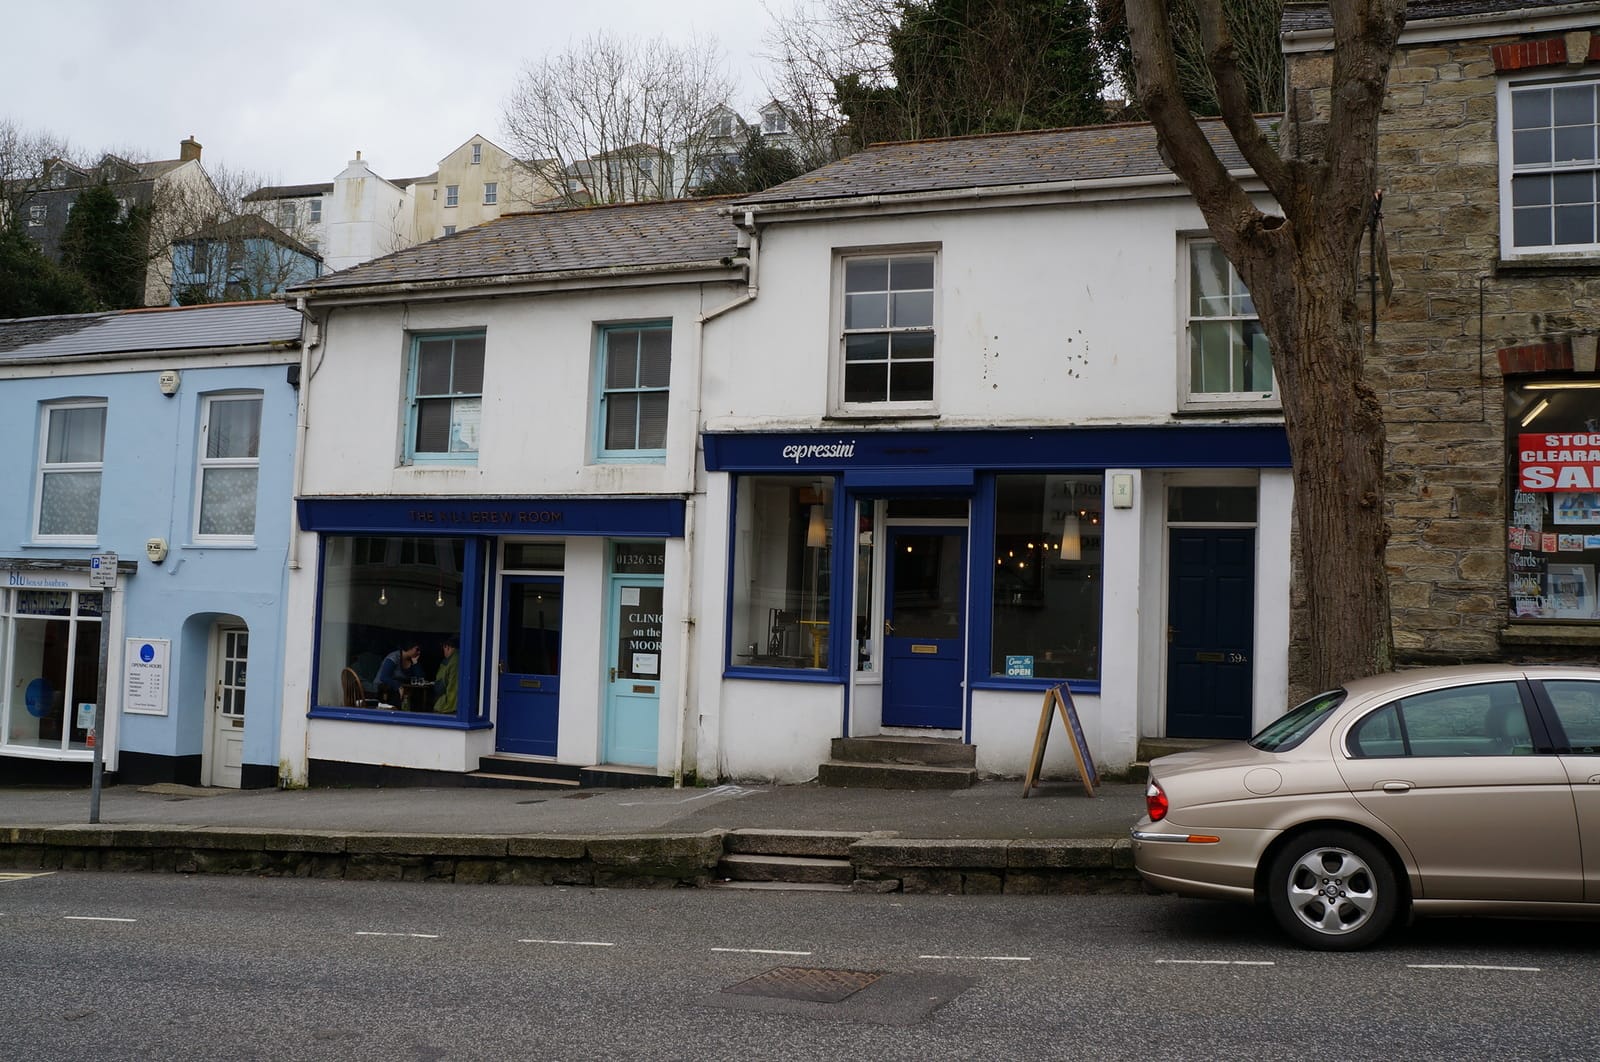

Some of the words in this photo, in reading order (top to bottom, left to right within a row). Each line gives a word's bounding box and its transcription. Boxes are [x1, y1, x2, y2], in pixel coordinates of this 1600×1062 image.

[1545, 434, 1600, 447] STOC
[782, 440, 856, 464] espressini
[1520, 450, 1600, 462] CLEARA
[1522, 466, 1600, 489] SA
[408, 510, 436, 522] THE
[518, 511, 563, 523] ROOM
[616, 554, 644, 565] 01326
[646, 555, 664, 565] 315
[1513, 552, 1537, 567] Cards
[9, 571, 26, 586] blu
[1513, 573, 1537, 588] Books
[633, 628, 644, 637] on
[646, 626, 661, 637] the
[629, 640, 663, 651] MOOR
[1008, 668, 1031, 676] OPEN
